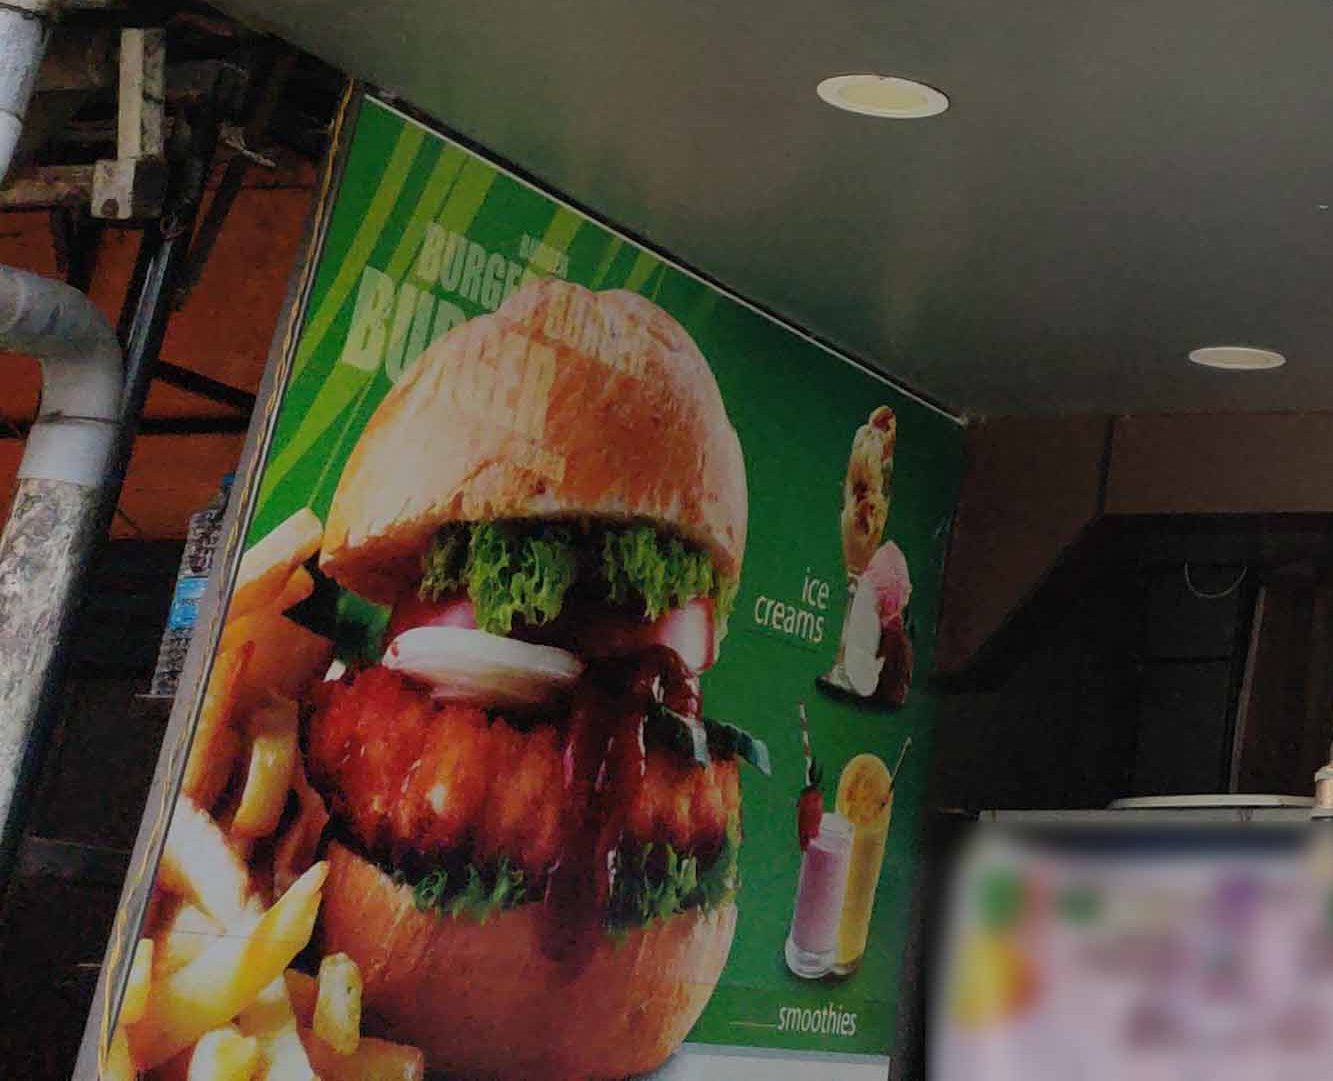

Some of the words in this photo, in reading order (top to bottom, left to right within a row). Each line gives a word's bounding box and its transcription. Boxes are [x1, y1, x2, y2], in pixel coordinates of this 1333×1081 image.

[802, 566, 830, 609] ice
[754, 595, 825, 643] creams
[777, 1002, 857, 1036] smoothies
